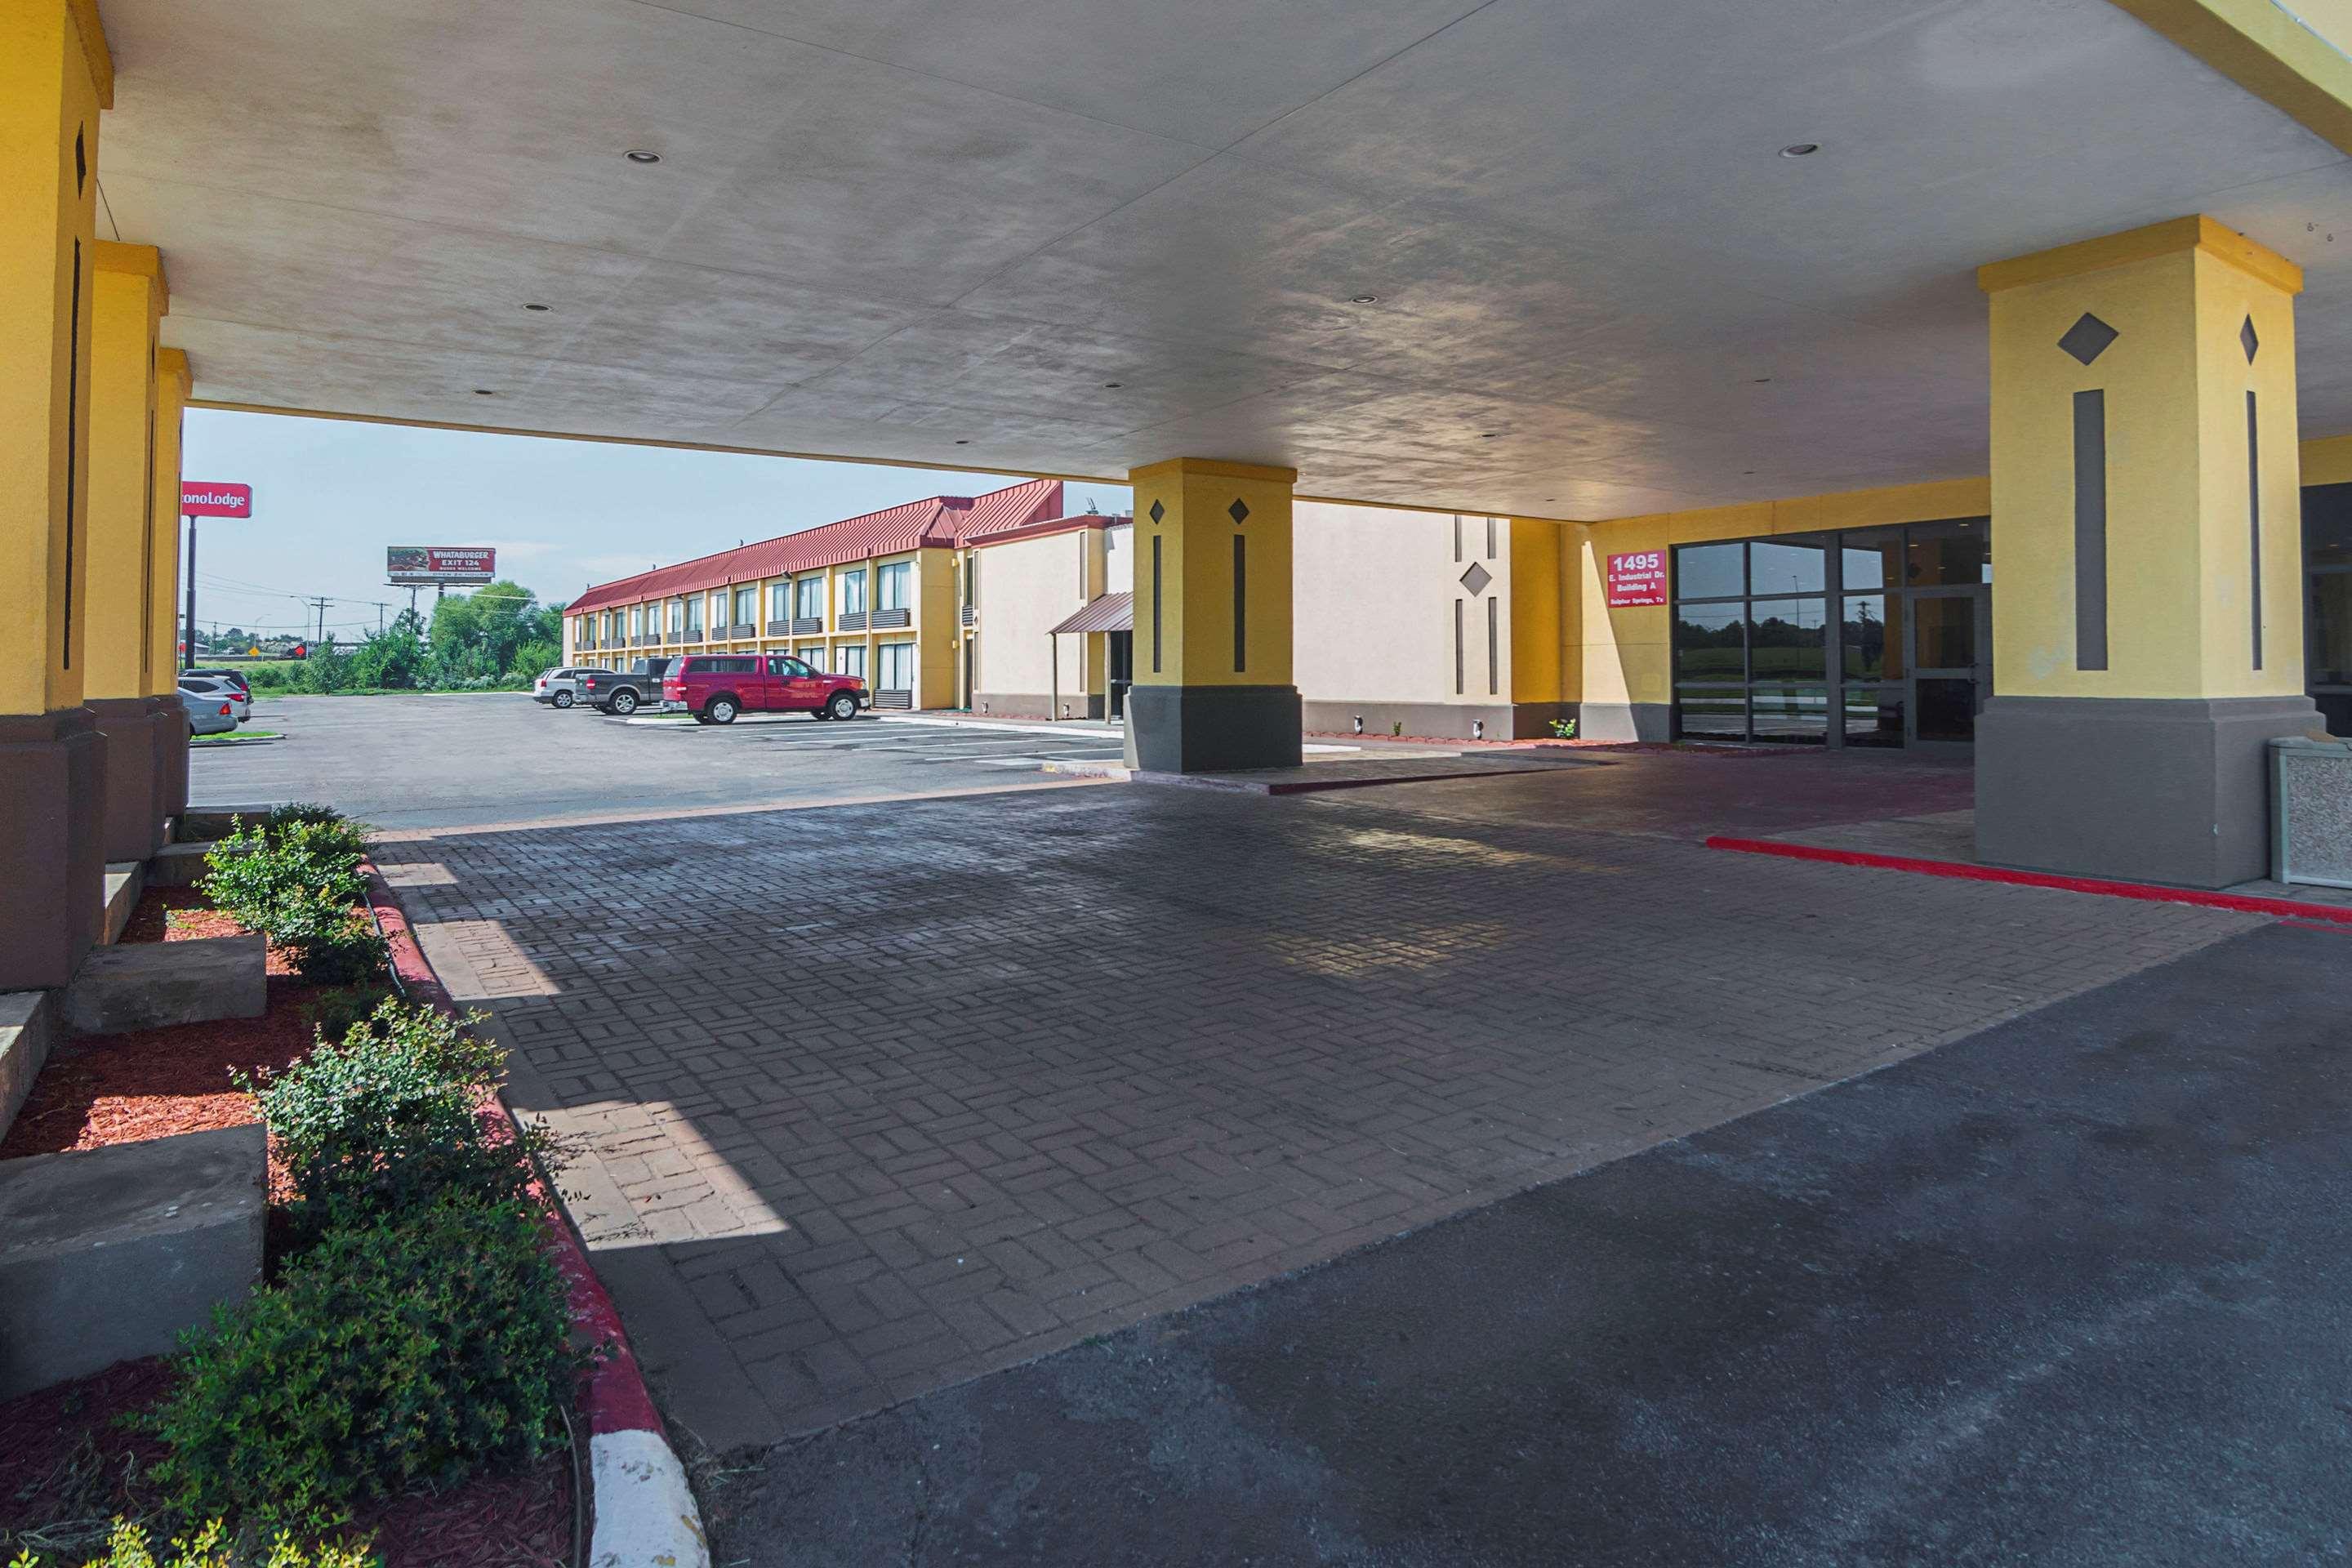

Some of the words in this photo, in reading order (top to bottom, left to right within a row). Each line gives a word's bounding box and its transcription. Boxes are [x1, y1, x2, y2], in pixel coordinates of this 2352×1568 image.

[182, 492, 246, 508] onoLodge
[433, 550, 489, 559] WHATABURGER
[1614, 554, 1659, 571] 1495
[1619, 572, 1651, 581] Industrial
[1617, 584, 1647, 592] Building
